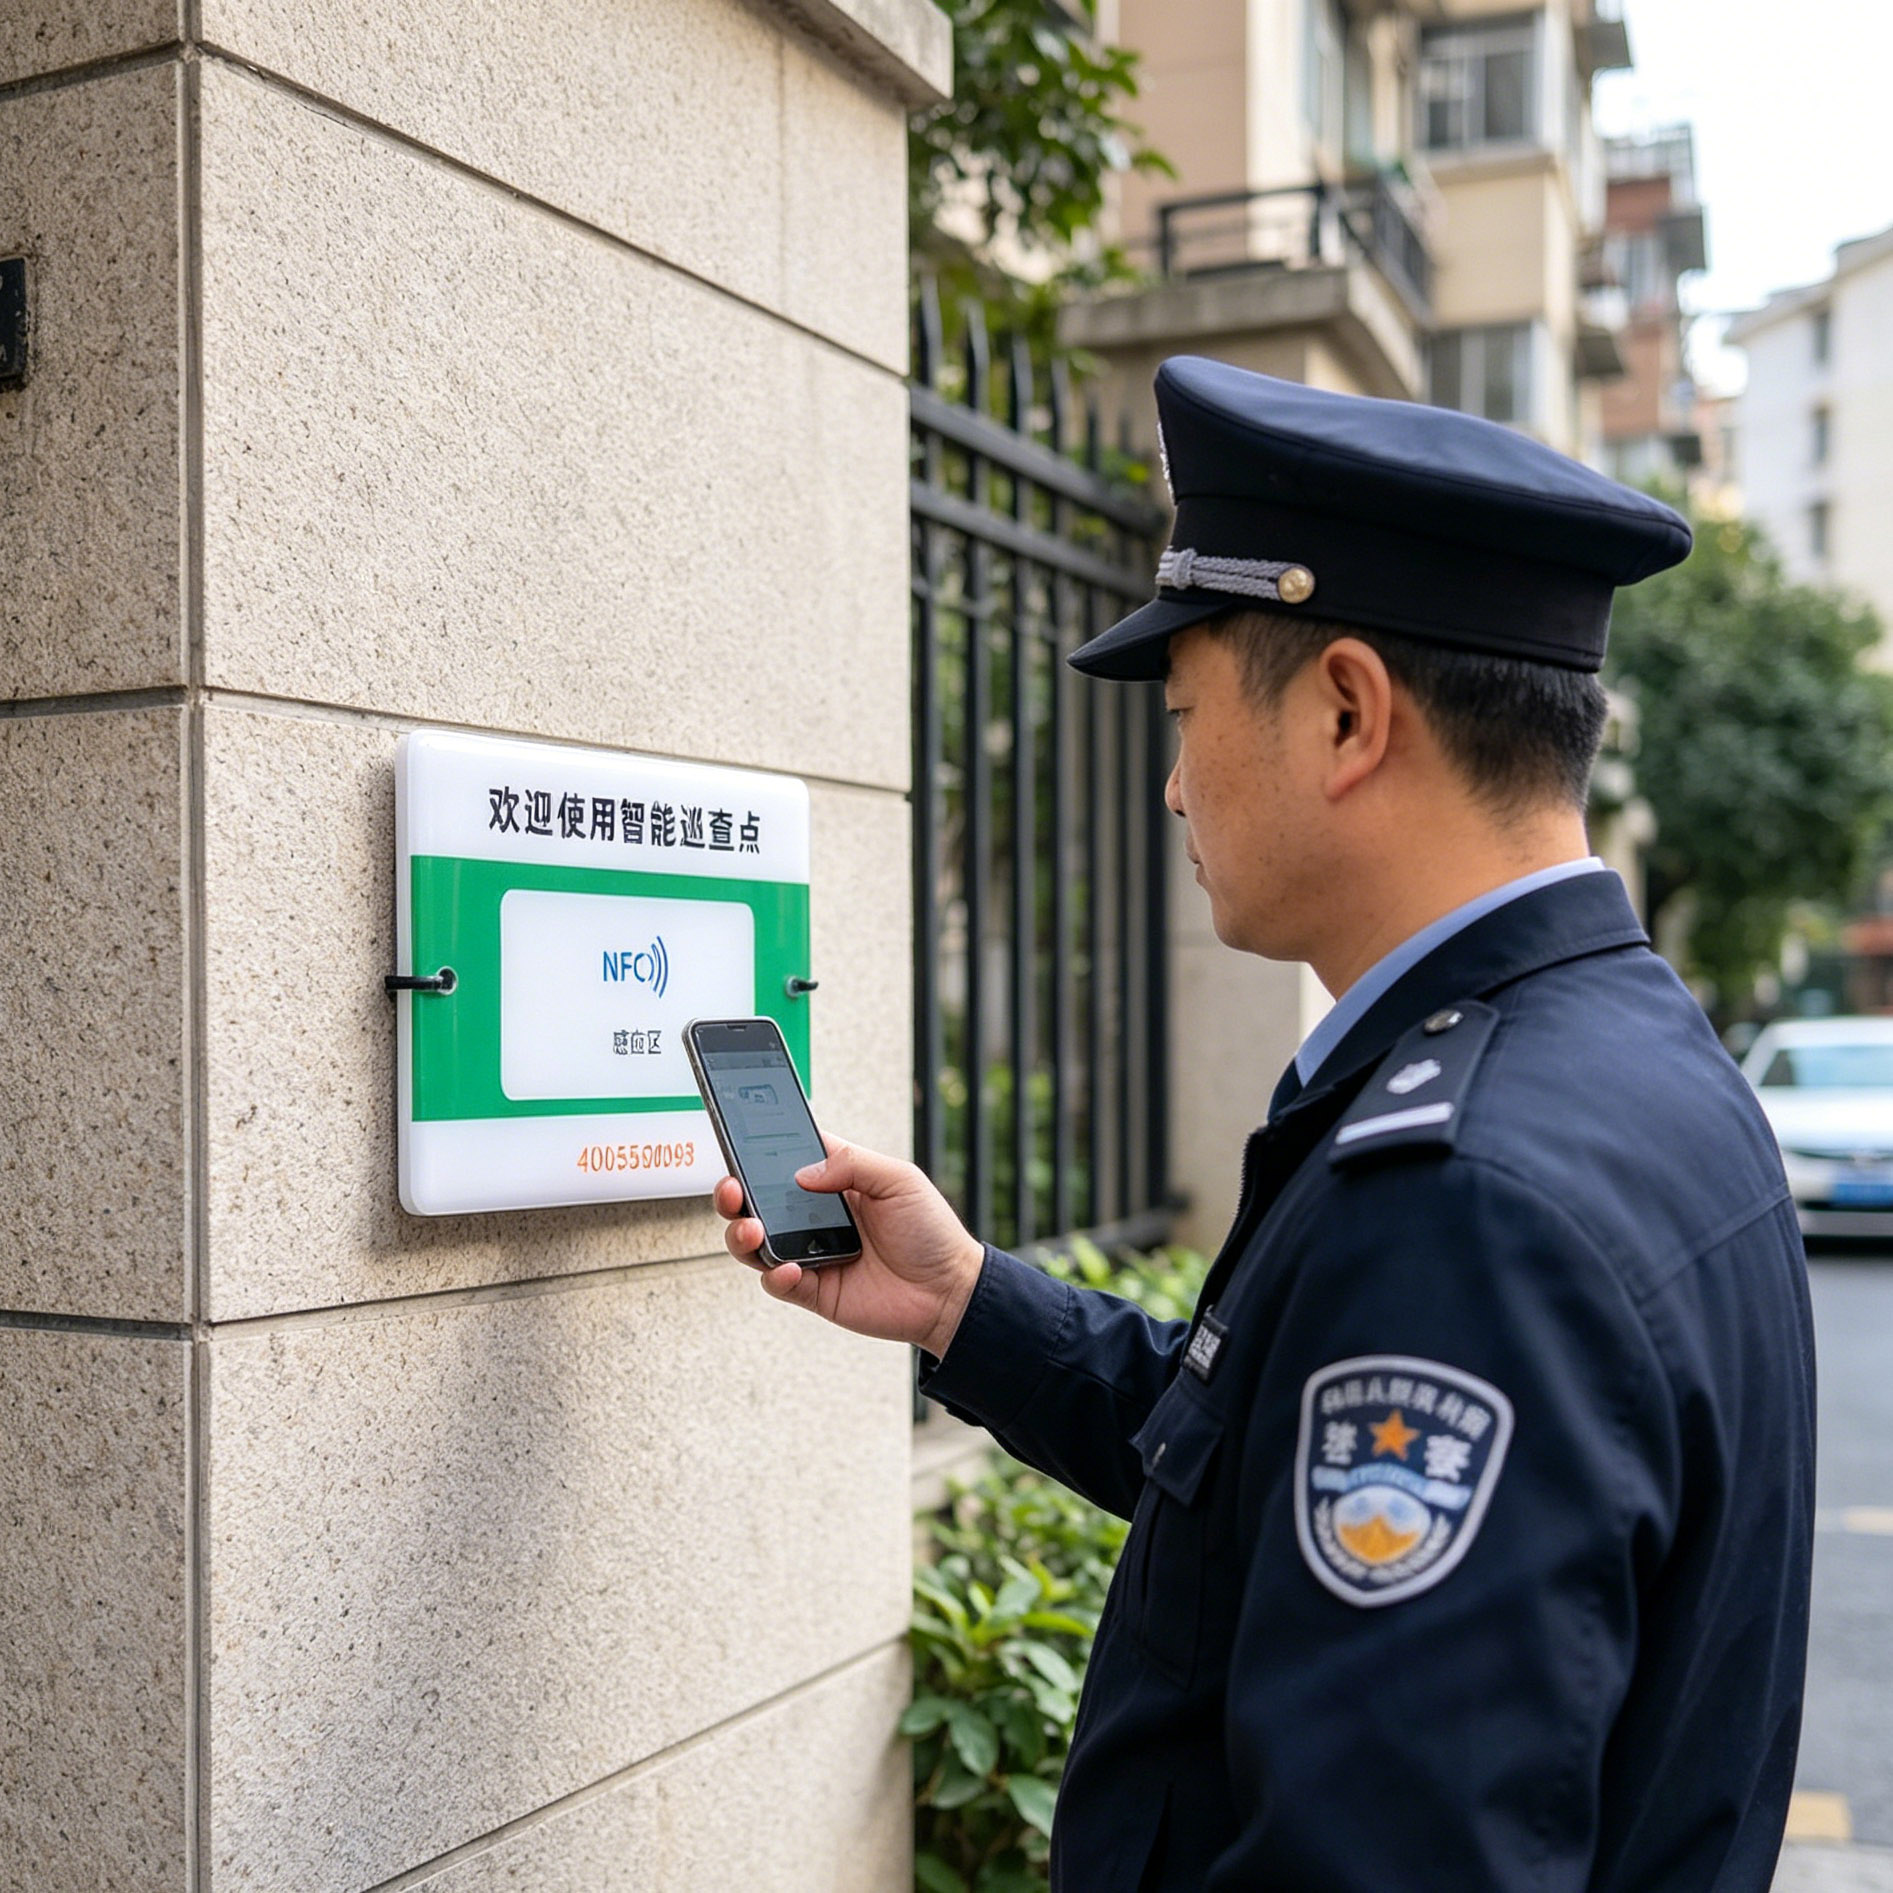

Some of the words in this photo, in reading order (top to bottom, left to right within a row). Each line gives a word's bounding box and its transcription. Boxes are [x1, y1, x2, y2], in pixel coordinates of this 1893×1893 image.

[488, 786, 761, 854] 欢迎使用智能巡查点
[603, 951, 648, 983] NFC
